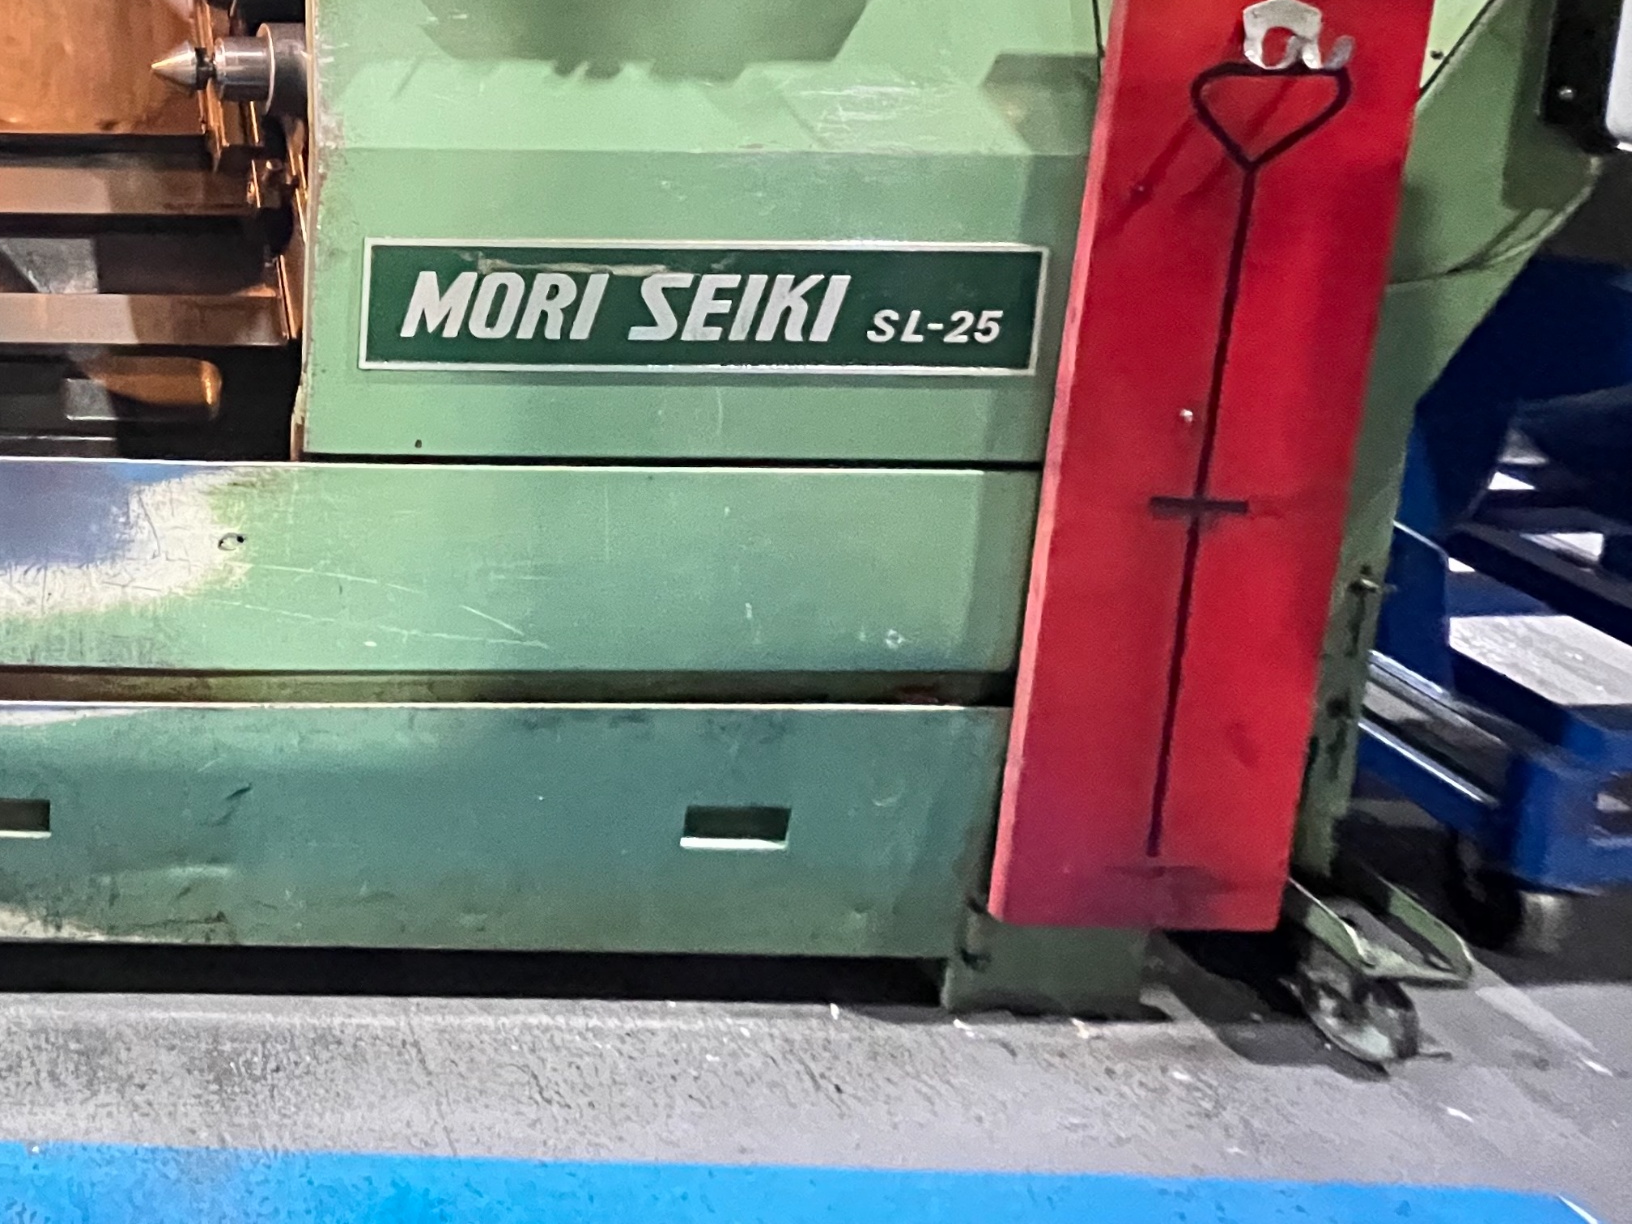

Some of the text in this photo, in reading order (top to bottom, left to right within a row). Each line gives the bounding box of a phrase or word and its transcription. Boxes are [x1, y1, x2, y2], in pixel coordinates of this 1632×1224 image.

[400, 270, 1005, 344] MORI SEIKI SL-25
